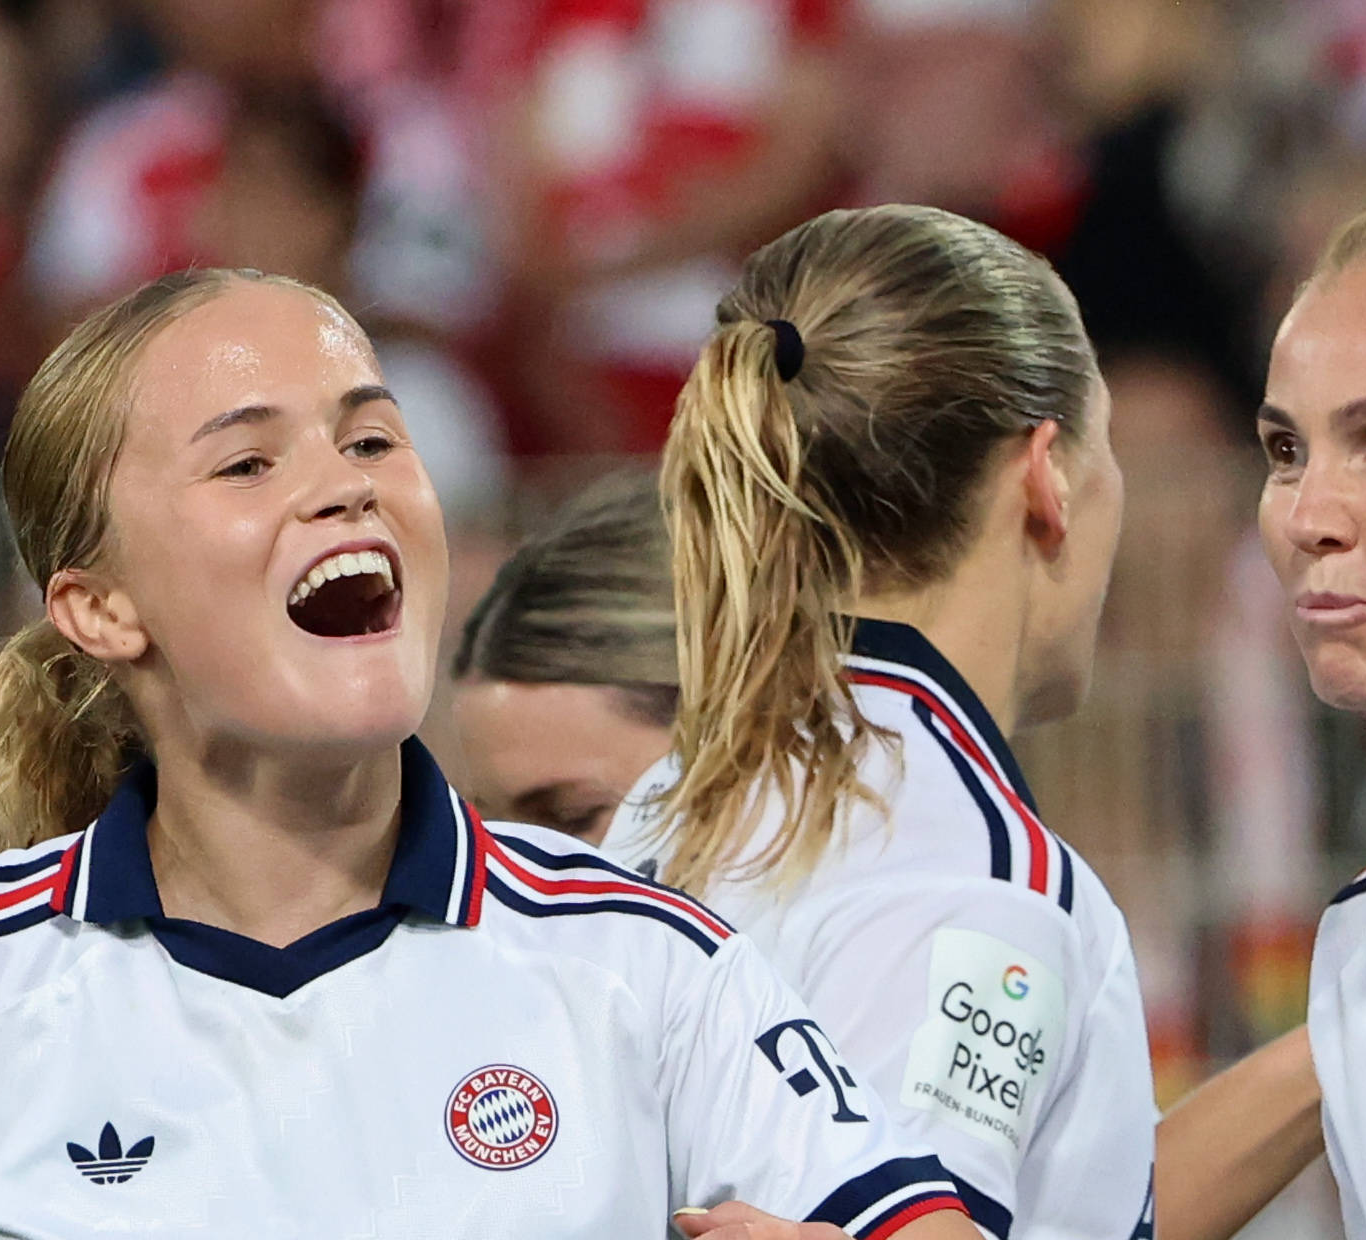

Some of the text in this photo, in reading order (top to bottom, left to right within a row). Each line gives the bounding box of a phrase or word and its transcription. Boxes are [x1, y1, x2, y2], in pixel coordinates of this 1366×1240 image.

[454, 1071, 544, 1112] FC BAYERN
[754, 1018, 869, 1123] T
[948, 1040, 1028, 1116] Pixel
[454, 1124, 541, 1163] MÜNCHEN
[914, 1082, 1020, 1149] FRAUEN-BUNDES
